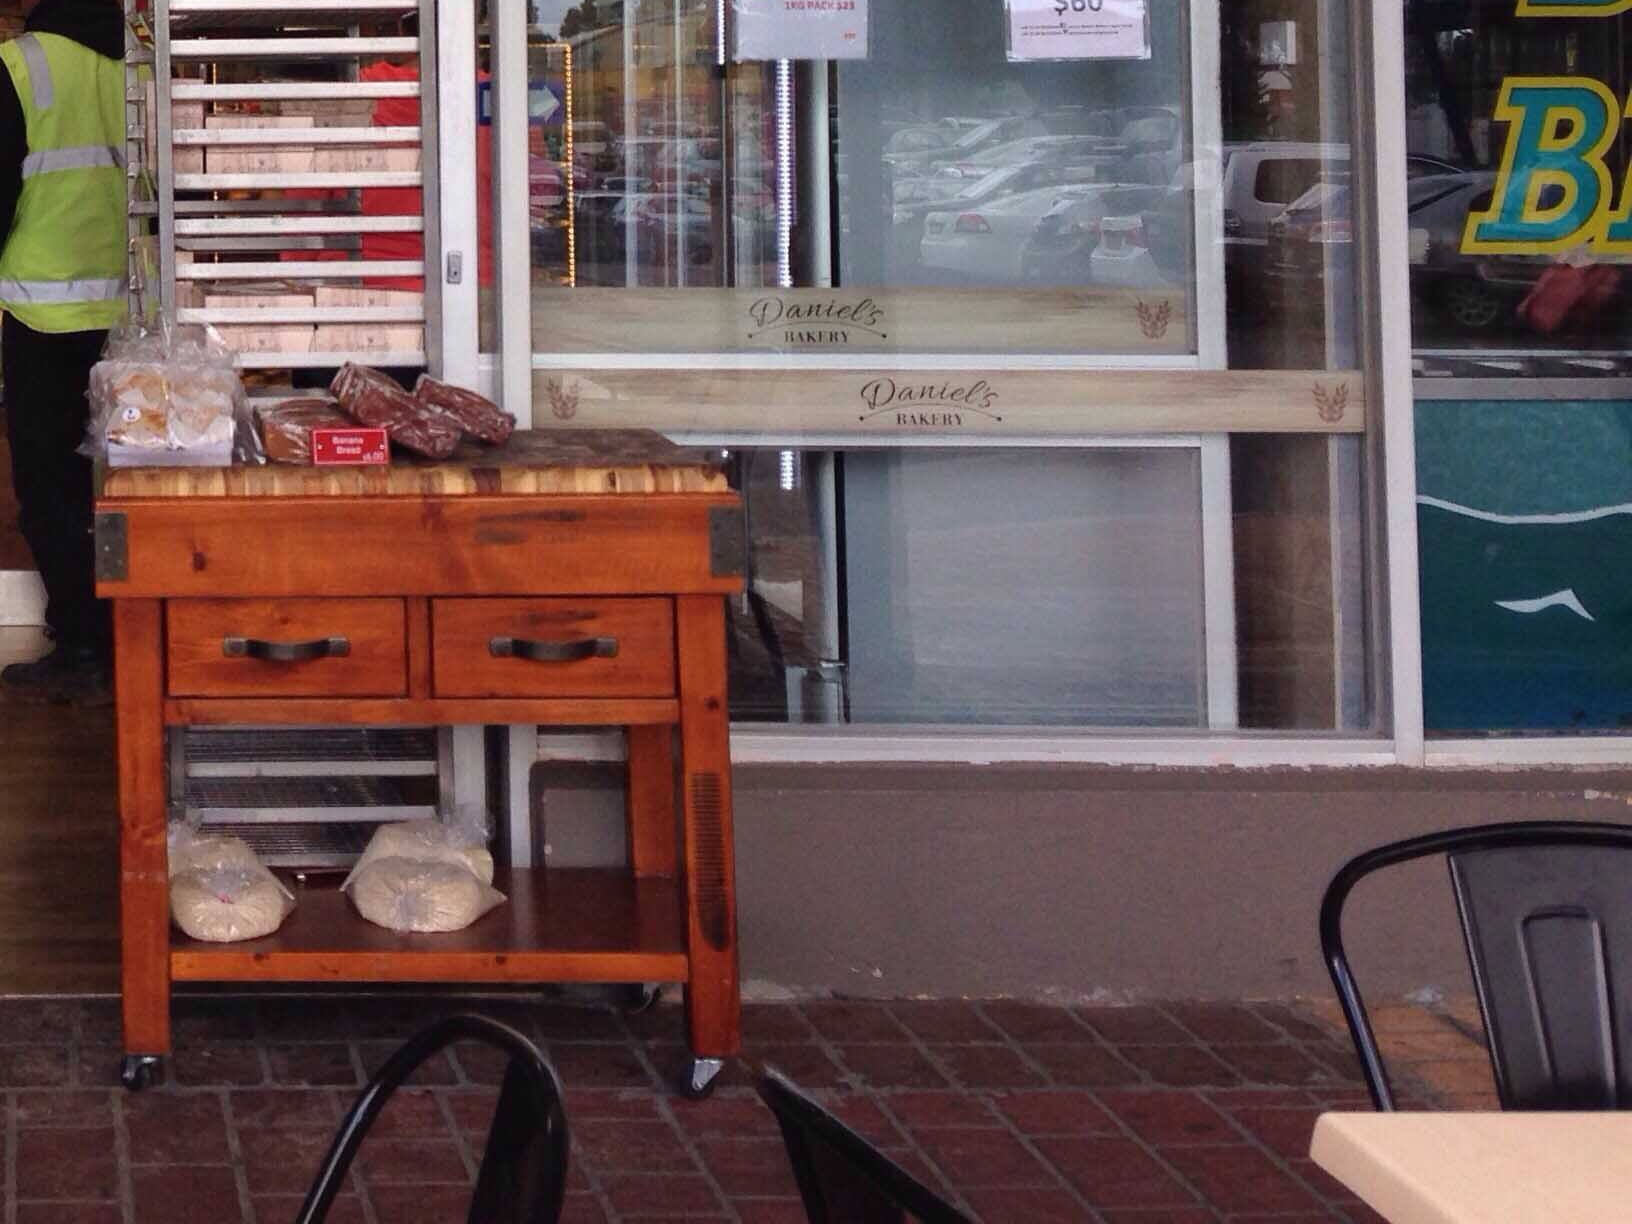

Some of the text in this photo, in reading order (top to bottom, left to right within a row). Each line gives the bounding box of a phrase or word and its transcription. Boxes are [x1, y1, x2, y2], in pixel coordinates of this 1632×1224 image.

[749, 297, 884, 327] Daniel's
[785, 331, 849, 343] BAKERY
[860, 378, 999, 409] Daniel's
[897, 413, 965, 426] BAKERY
